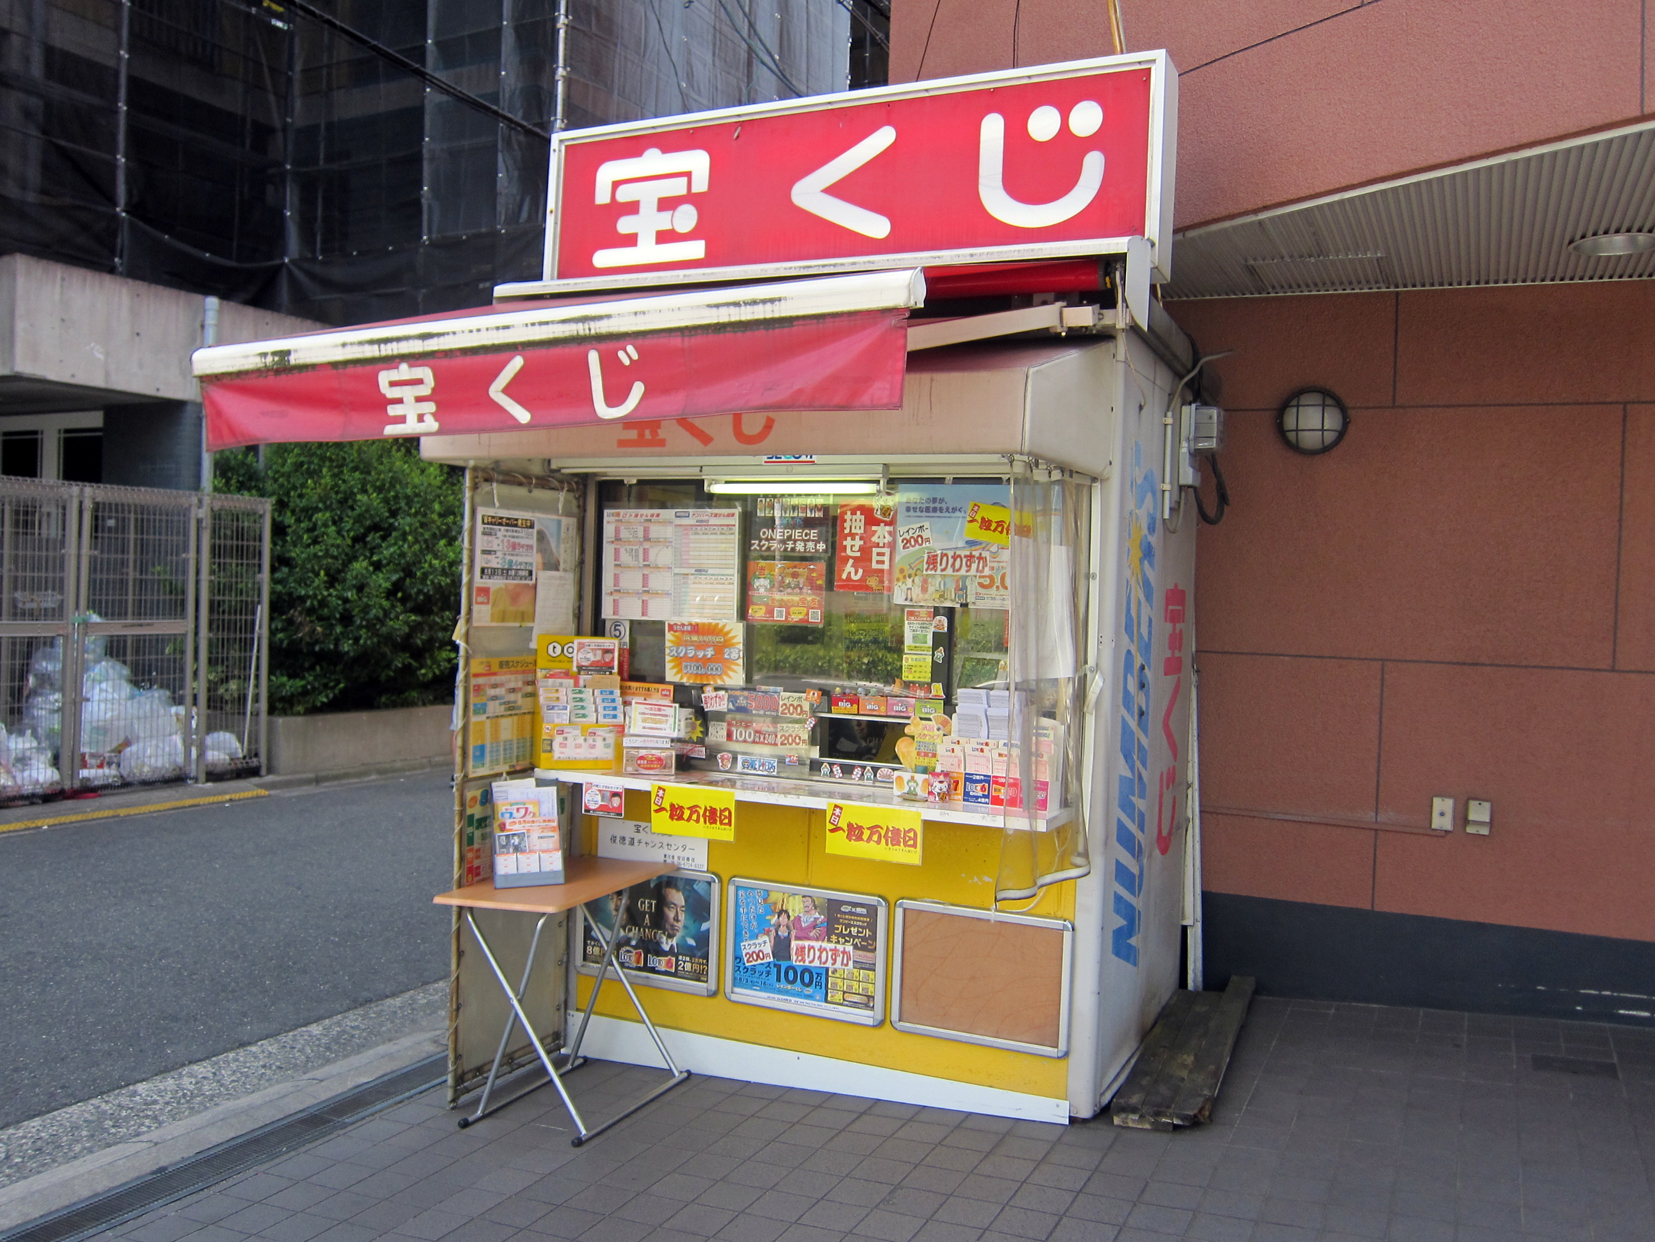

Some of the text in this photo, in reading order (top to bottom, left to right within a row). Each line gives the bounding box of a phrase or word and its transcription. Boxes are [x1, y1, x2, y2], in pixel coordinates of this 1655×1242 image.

[592, 100, 1105, 268] 宝くじ
[378, 345, 645, 436] 宝くじ
[905, 505, 967, 515] 幸せな医療をえがく。
[898, 524, 929, 538] レインボー
[750, 539, 827, 553] スクラッチ発売中
[841, 510, 866, 581] 抽せん
[870, 522, 894, 570] 本日
[901, 534, 931, 550] 200円
[924, 551, 989, 574] 残りわずか
[668, 645, 716, 660] スクラッチ
[780, 703, 808, 718] 200円
[838, 700, 852, 708] BIG
[866, 702, 879, 711] BIG
[893, 703, 907, 712] BIG
[921, 705, 936, 714] BIG
[1112, 440, 1158, 968] NUMBERS
[1156, 582, 1186, 856] 宝くじ
[779, 733, 808, 747] 200円
[654, 787, 666, 807] 本日
[653, 801, 733, 829] 一粒万倍日
[830, 806, 843, 826] 本日
[827, 820, 919, 850] 一粒万倍日
[609, 834, 696, 853] 俊徳道チャンスセンター
[637, 898, 657, 913] GET
[643, 913, 651, 927] A
[833, 924, 873, 938] プレゼント
[741, 939, 769, 951] スクラッチ
[829, 934, 876, 949] キャンペーン
[744, 949, 772, 964] 200円
[794, 943, 852, 968] 残りわずか
[734, 965, 772, 978] スクラッチ
[773, 963, 823, 990] 100 万円
